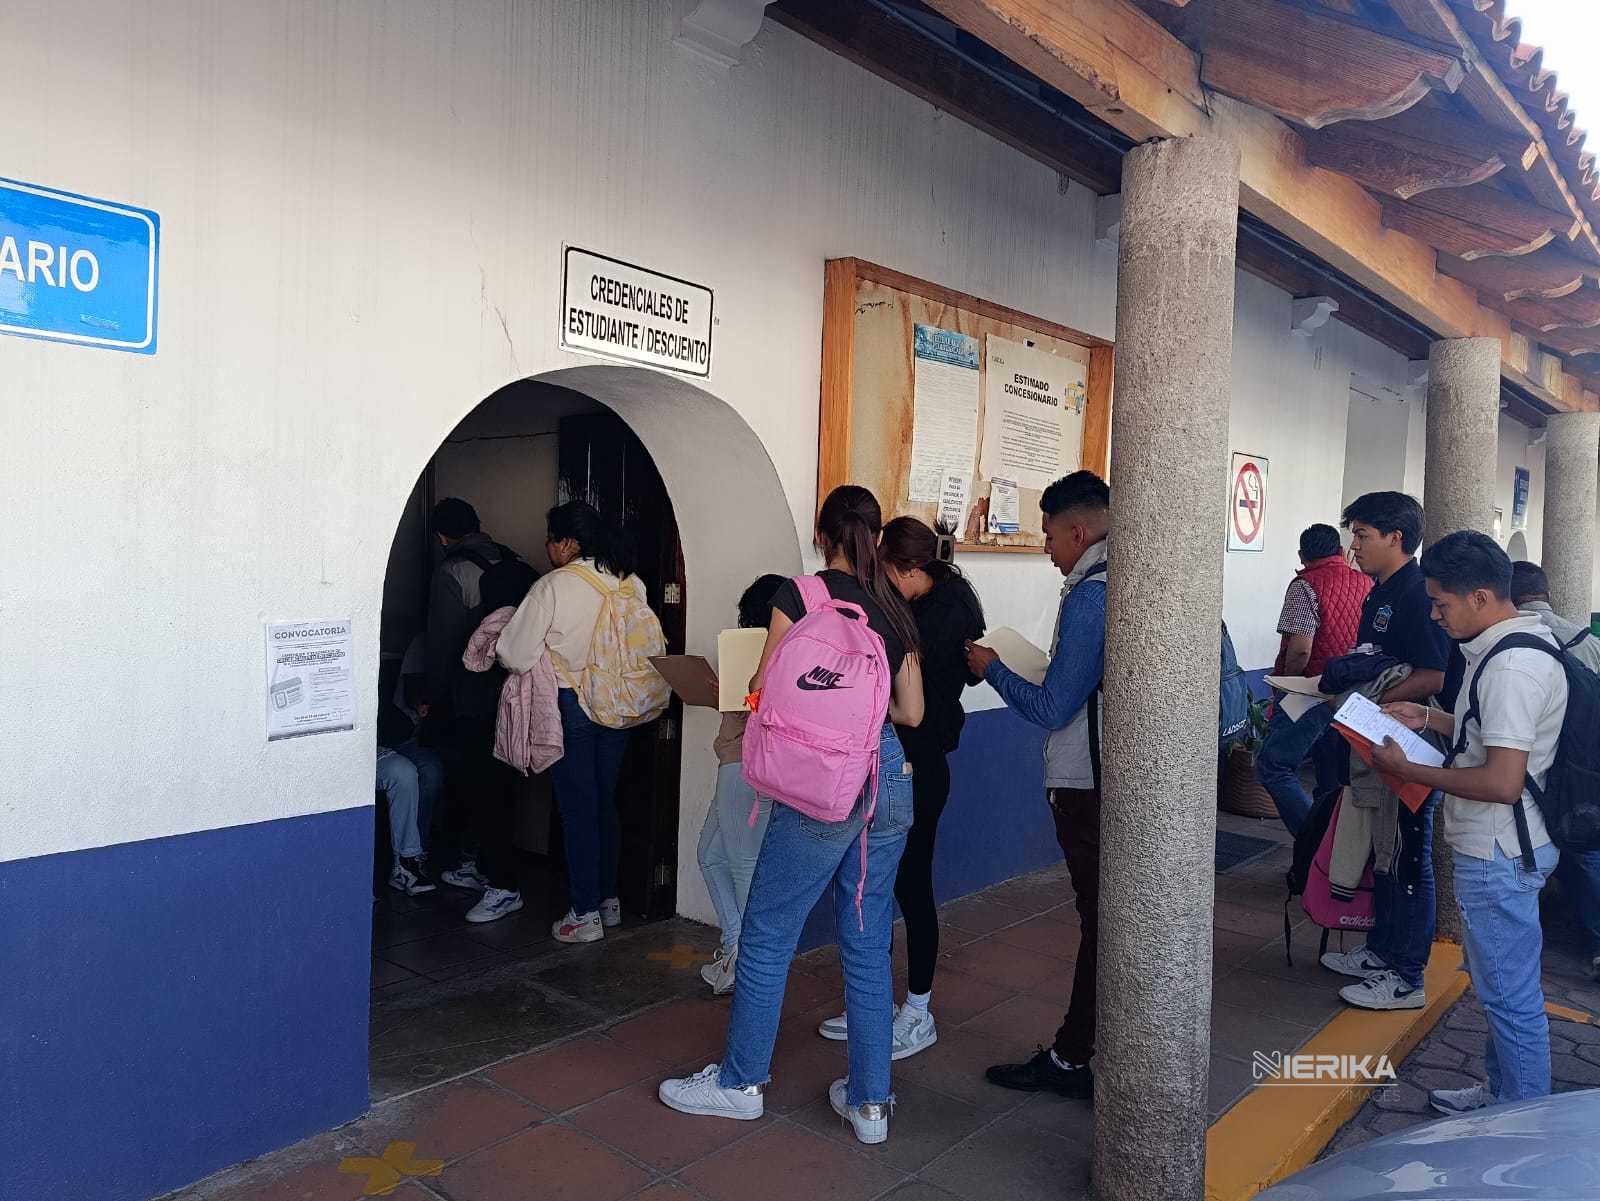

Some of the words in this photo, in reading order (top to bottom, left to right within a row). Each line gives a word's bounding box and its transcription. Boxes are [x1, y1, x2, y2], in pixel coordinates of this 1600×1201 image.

[0, 235, 99, 293] ARIO
[590, 274, 673, 321] CREDENCIALES
[675, 297, 689, 325] DE
[568, 307, 639, 350] ESTUDIANTE
[646, 327, 707, 366] DESCUENTO
[1014, 373, 1049, 391] ESTIMADO
[1004, 383, 1058, 407] CONCESIONARIO
[274, 626, 346, 640] CONVOCATORIA
[807, 665, 845, 686] NIKE
